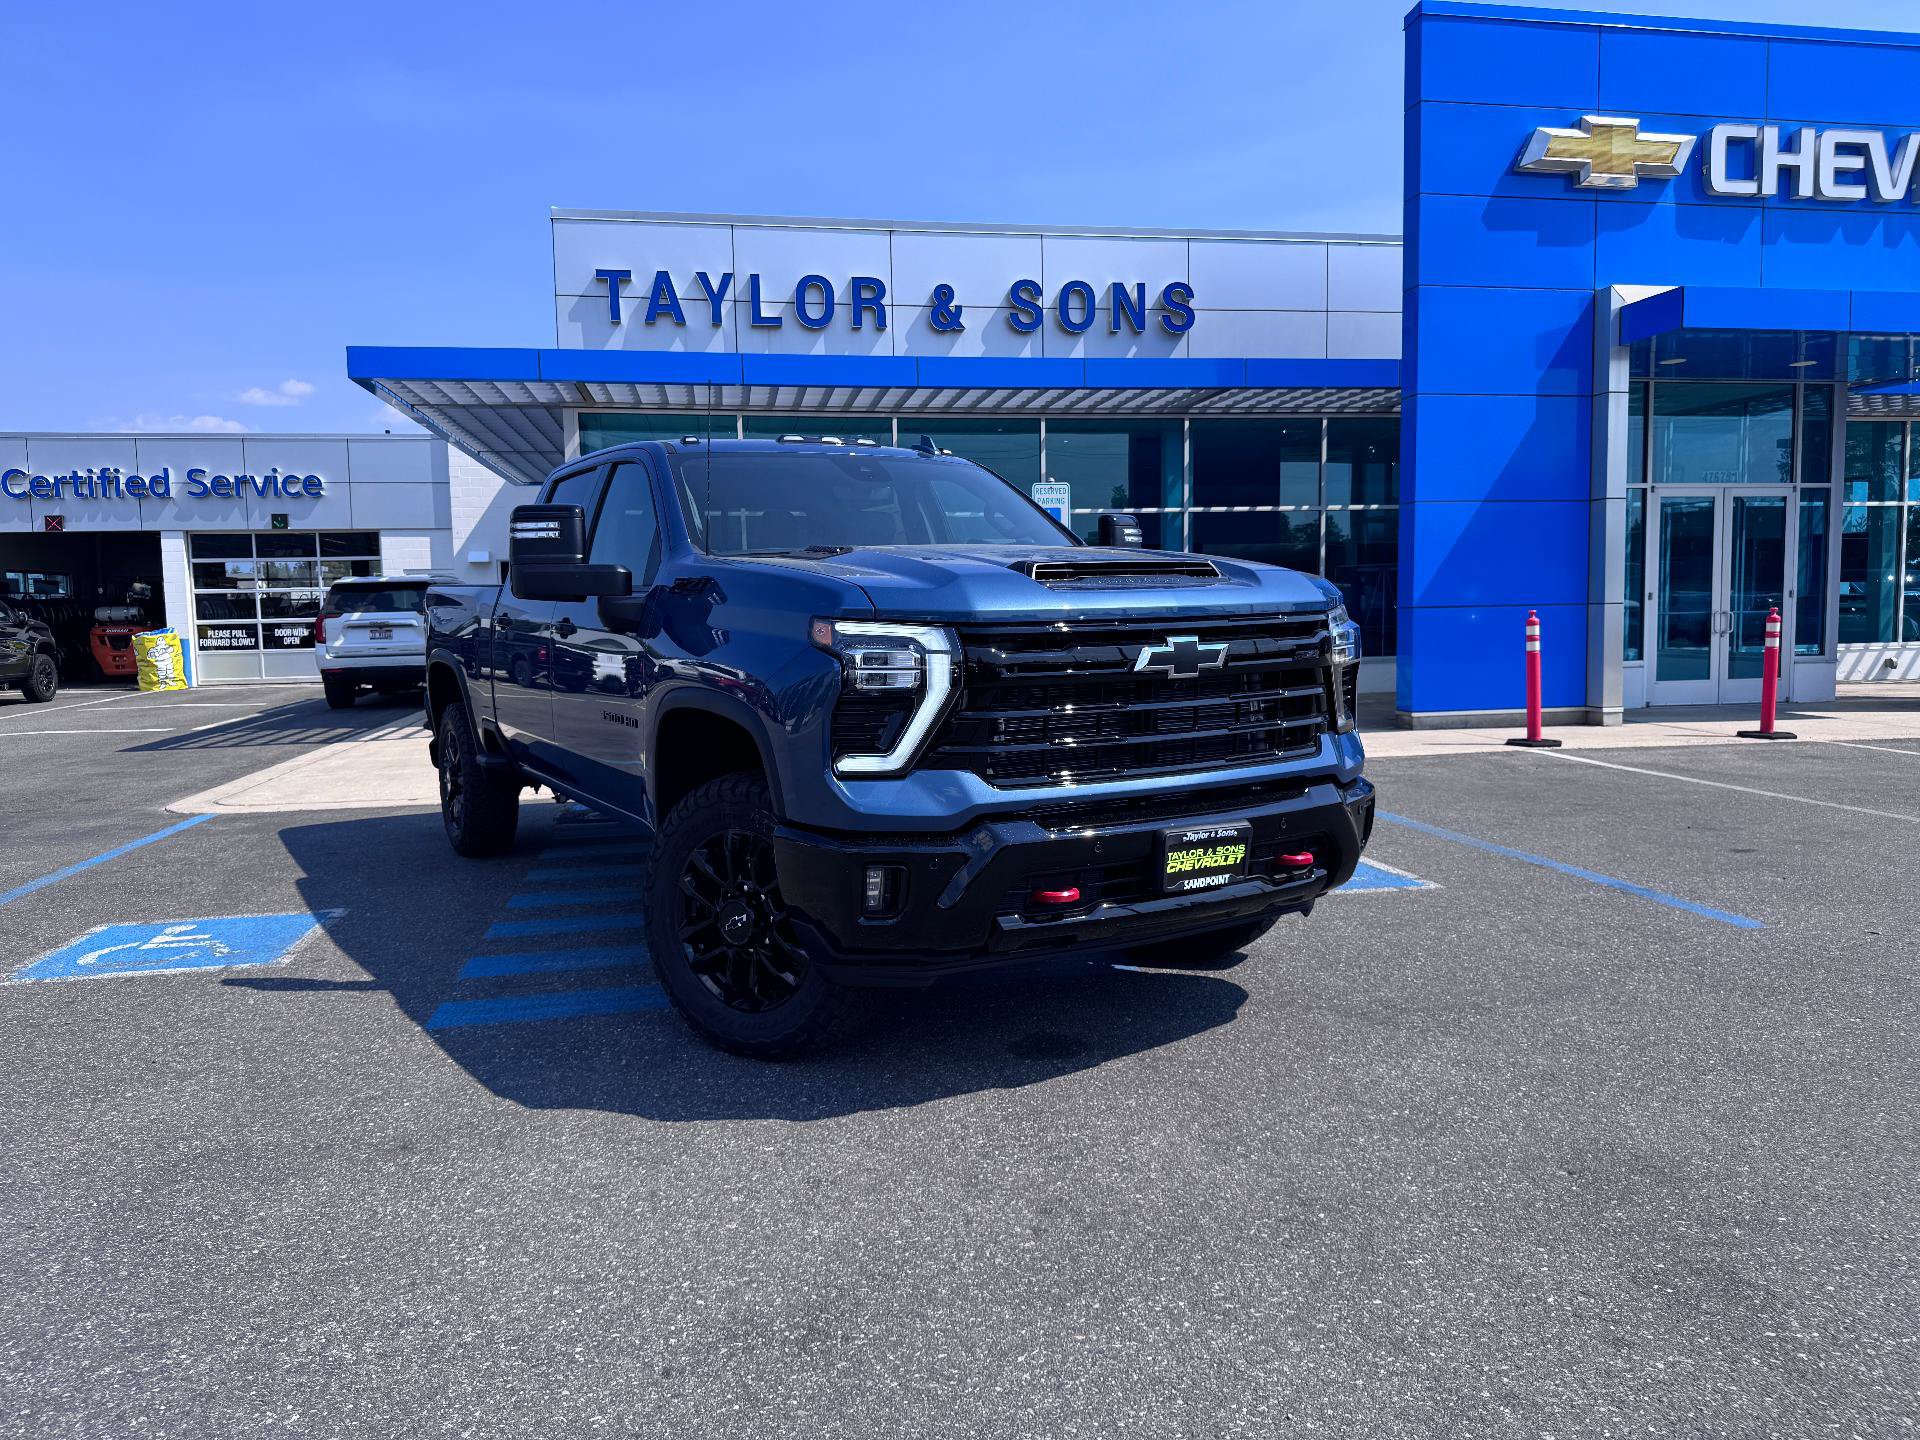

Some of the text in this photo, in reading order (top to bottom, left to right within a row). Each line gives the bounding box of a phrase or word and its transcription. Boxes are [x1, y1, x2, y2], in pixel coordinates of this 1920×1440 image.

[595, 269, 1196, 335] TAYLOR & SONS
[1, 467, 324, 499] Certified Service
[1036, 487, 1067, 495] RESERVED
[1037, 497, 1065, 505] PARKING
[207, 630, 247, 638] PLEASE PULL
[292, 628, 308, 636] WILL
[200, 638, 255, 646] FORWARD SLOWLY
[1187, 831, 1210, 841] Taylor
[1167, 844, 1246, 861] TAYLOR & SONS
[1166, 854, 1245, 873] CHEVROLET
[1183, 874, 1230, 890] SANDPOINT
